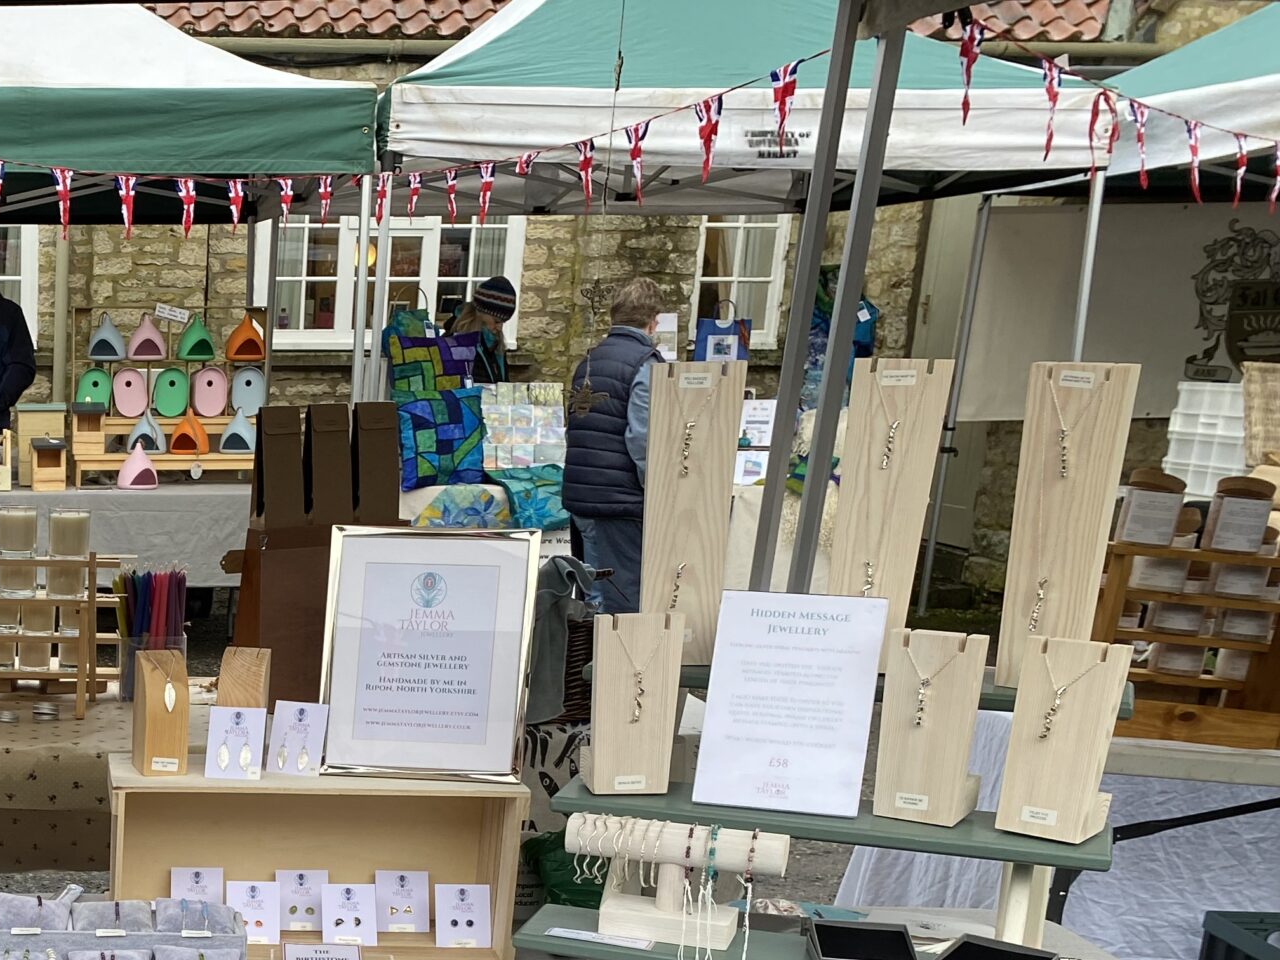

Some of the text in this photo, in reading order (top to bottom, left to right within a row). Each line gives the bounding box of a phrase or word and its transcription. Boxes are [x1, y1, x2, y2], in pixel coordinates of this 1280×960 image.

[409, 608, 455, 620] JEMMA
[750, 608, 852, 623] HIDDEN MESSAGE
[397, 619, 449, 631] TAYLOR
[767, 624, 830, 636] JEWELLERY
[380, 652, 417, 660] ARTISAN
[377, 660, 470, 670] GEMSTONE JEWELLERY
[379, 676, 428, 685] HANDMADE
[430, 678, 441, 686] BY
[365, 683, 478, 695] RIPON, NORTH YORKSHIRE
[769, 757, 789, 768] £58
